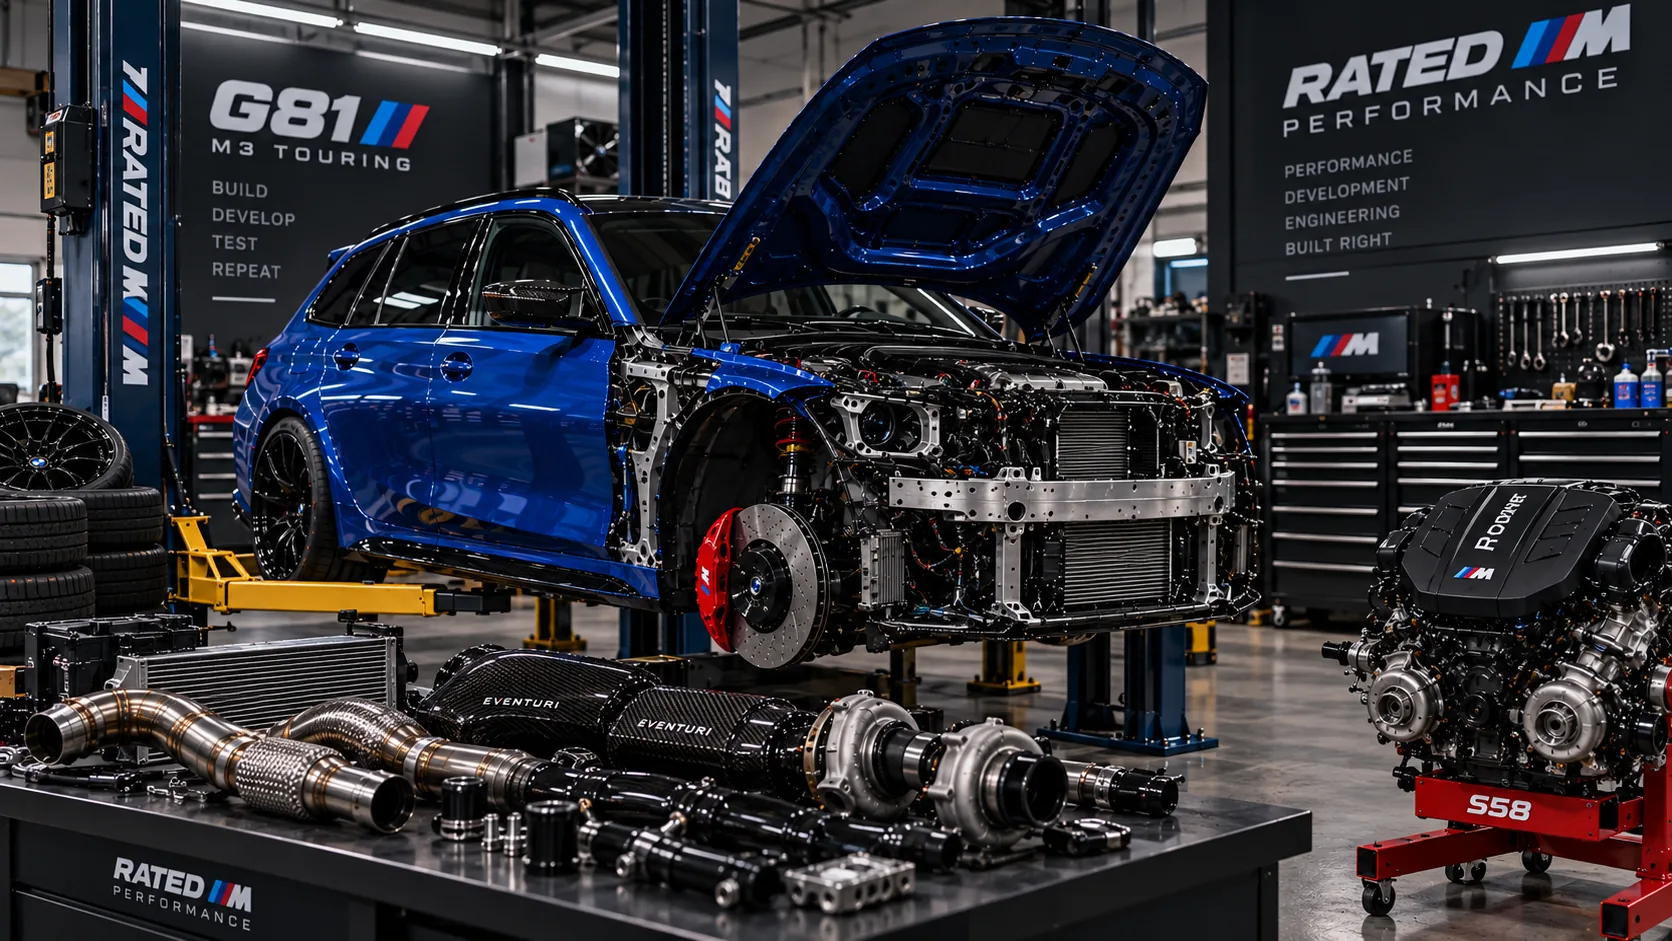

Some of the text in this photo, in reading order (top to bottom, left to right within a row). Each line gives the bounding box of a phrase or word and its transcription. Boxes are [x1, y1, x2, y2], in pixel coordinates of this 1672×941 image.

[1282, 3, 1631, 108] RATED M
[209, 79, 362, 143] G81
[1283, 67, 1618, 138] PERFORMANCE
[211, 138, 411, 172] M3 TOURING
[1284, 149, 1413, 179] PERFORMANCE
[122, 117, 148, 264] RATED
[212, 180, 268, 198] BUILD
[1285, 176, 1410, 205] DEVELOPMENT
[212, 207, 295, 227] DEVELOP
[1285, 204, 1401, 230] ENGINEERING
[211, 234, 258, 251] TEST
[1285, 232, 1393, 256] BUILT RIGHT
[212, 261, 282, 279] REPEAT
[1341, 332, 1379, 357] M
[122, 344, 148, 386] M
[1468, 567, 1495, 580] M
[482, 697, 560, 709] EVENTURI
[637, 718, 713, 737] EVENTURI
[1466, 794, 1532, 821] S58
[113, 856, 252, 913] RATED M
[113, 885, 251, 931] PERFORMANCE
